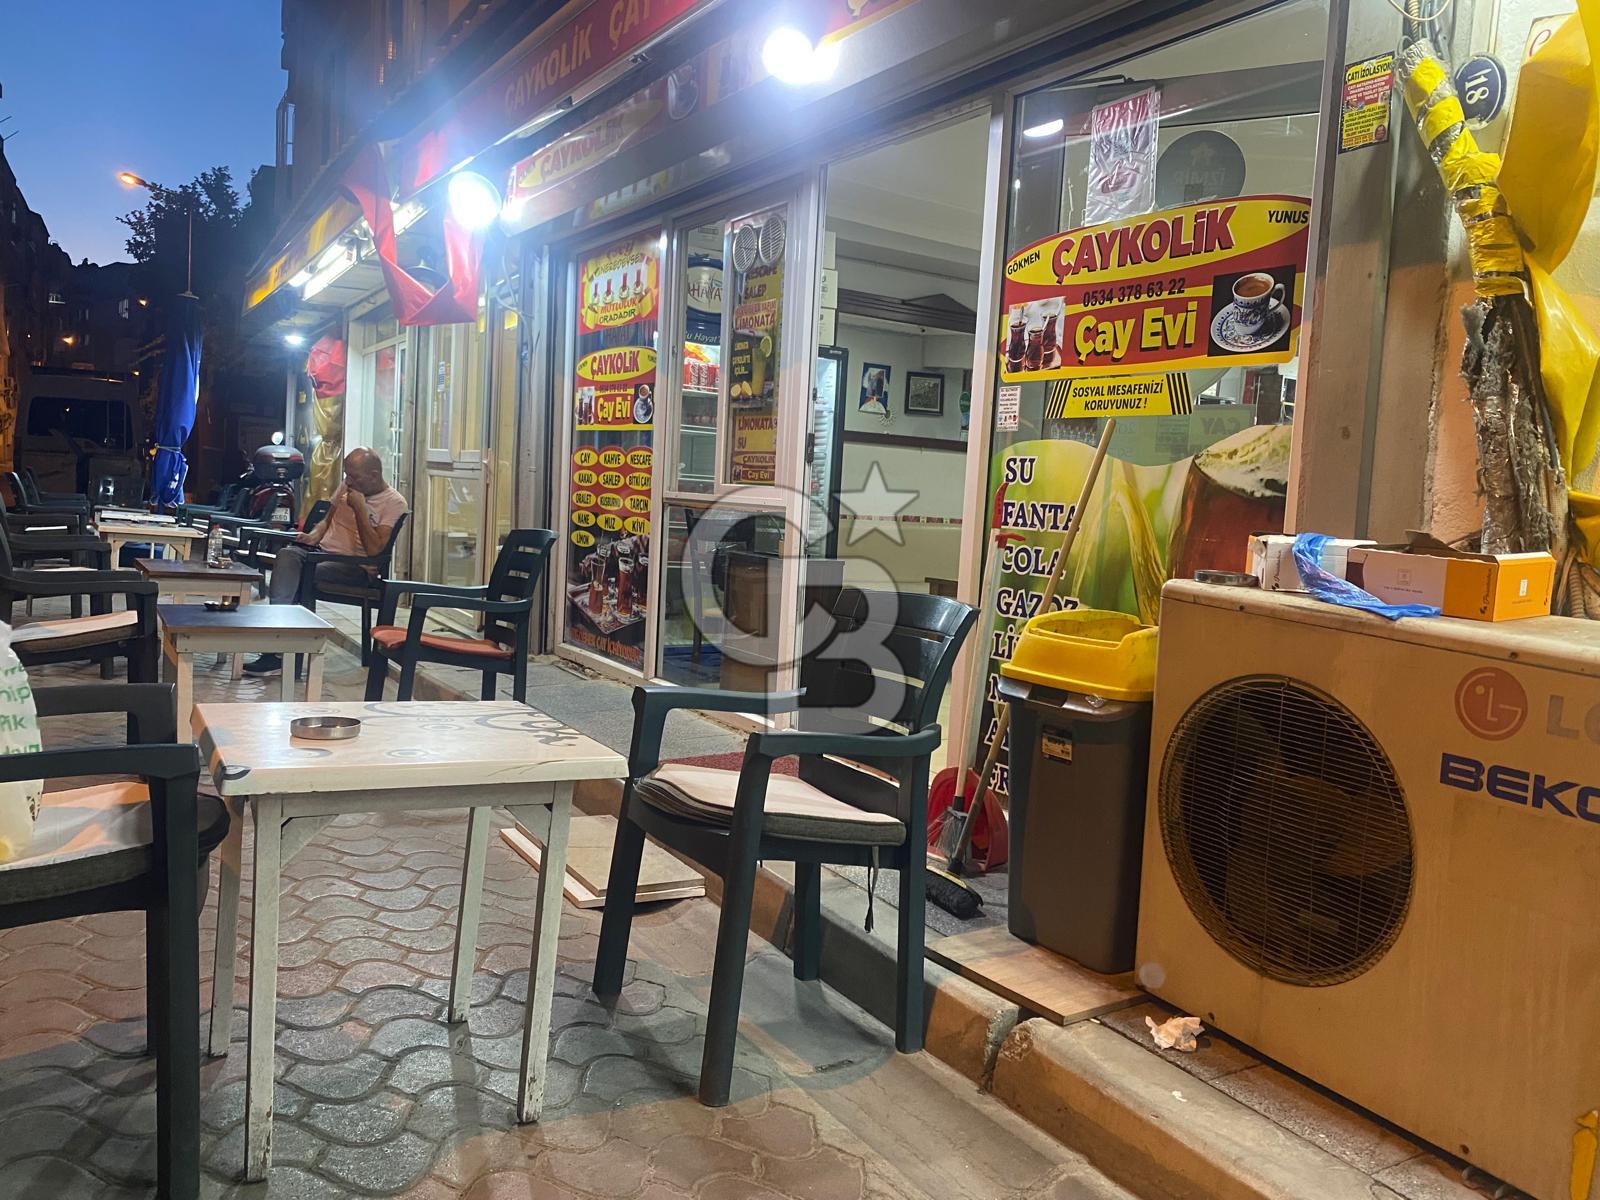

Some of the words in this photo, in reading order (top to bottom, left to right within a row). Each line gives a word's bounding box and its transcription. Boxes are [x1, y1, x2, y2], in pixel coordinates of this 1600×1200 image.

[1267, 209, 1309, 224] YUNUS
[1051, 204, 1238, 286] ÇAYKOLİK
[1007, 249, 1041, 275] GÖKMEN
[1083, 288, 1114, 308] 0534
[1117, 284, 1143, 303] 378
[1146, 281, 1165, 299] 63
[1167, 277, 1187, 296] 22
[1074, 314, 1137, 366] Çay
[1140, 301, 1197, 352] Evi
[590, 350, 640, 380] ÇAYKOLİK
[1072, 383, 1105, 398] SOSYAL
[1107, 378, 1165, 396] MESAFENİZİ
[597, 397, 615, 424] Çay
[615, 395, 632, 420] Evi
[1083, 398, 1142, 411] KORUYUNUZ
[603, 454, 621, 465] KAHVE
[630, 454, 651, 466] NESCAFE
[748, 470, 759, 480] Çay
[760, 470, 770, 479] Evi
[1005, 456, 1037, 484] SU
[630, 498, 649, 511] TARÇIN
[604, 517, 616, 529] MUZ
[632, 518, 645, 532] KİVİ
[1002, 501, 1079, 533] FANTA
